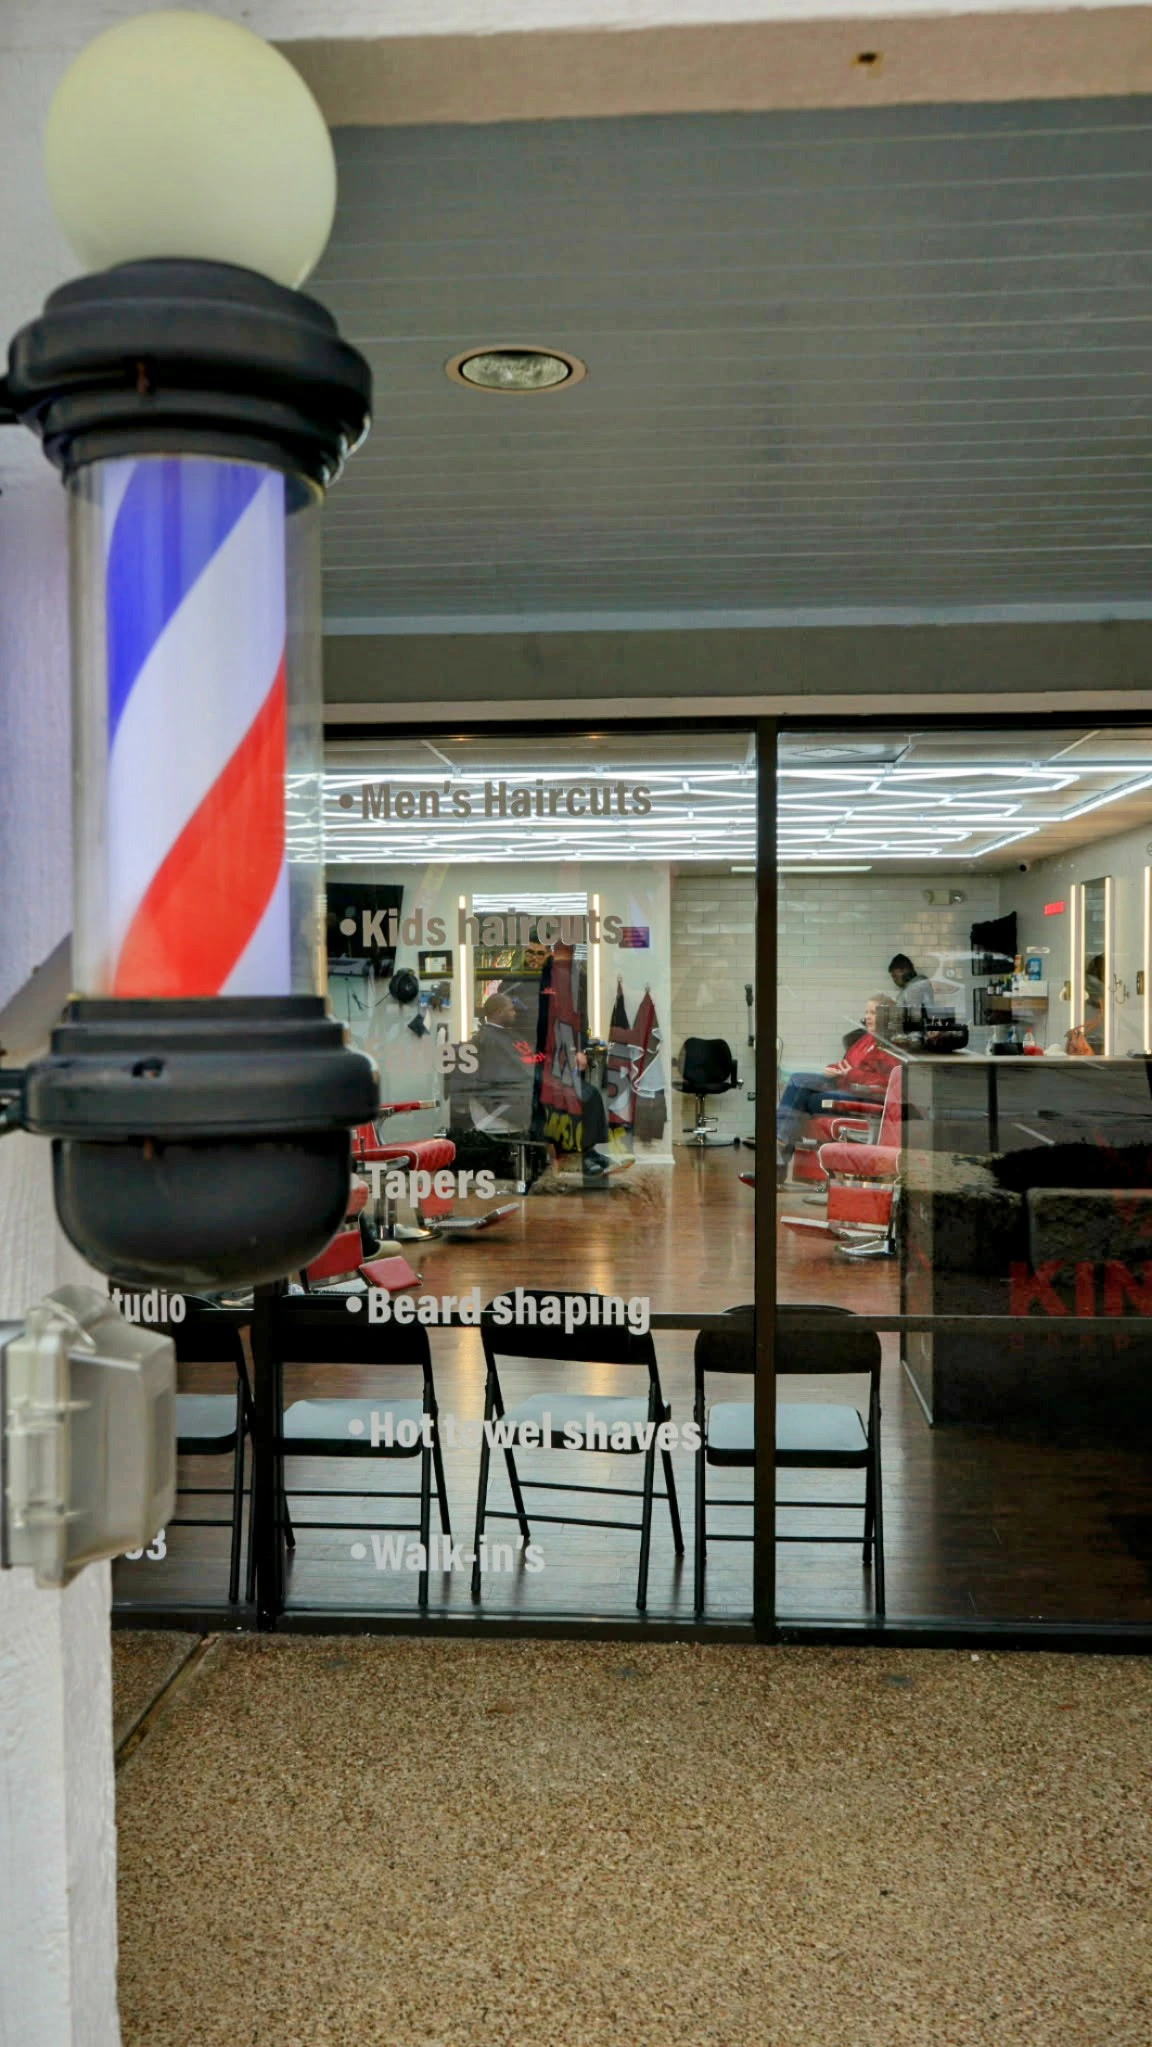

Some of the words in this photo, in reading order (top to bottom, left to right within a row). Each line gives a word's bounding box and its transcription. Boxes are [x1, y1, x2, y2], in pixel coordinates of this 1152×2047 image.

[361, 780, 472, 819] Men's
[484, 779, 652, 818] Haircuts
[362, 908, 447, 948] Kids
[458, 907, 624, 946] haircuts
[366, 1163, 496, 1208] Tapers
[1009, 1260, 1152, 1317] KIN
[368, 1286, 482, 1324] Beard
[492, 1286, 650, 1336] shaping
[370, 1411, 434, 1448] Hot
[446, 1411, 552, 1449] towel
[562, 1412, 702, 1451] shaves
[371, 1534, 546, 1573] Walk-in's
